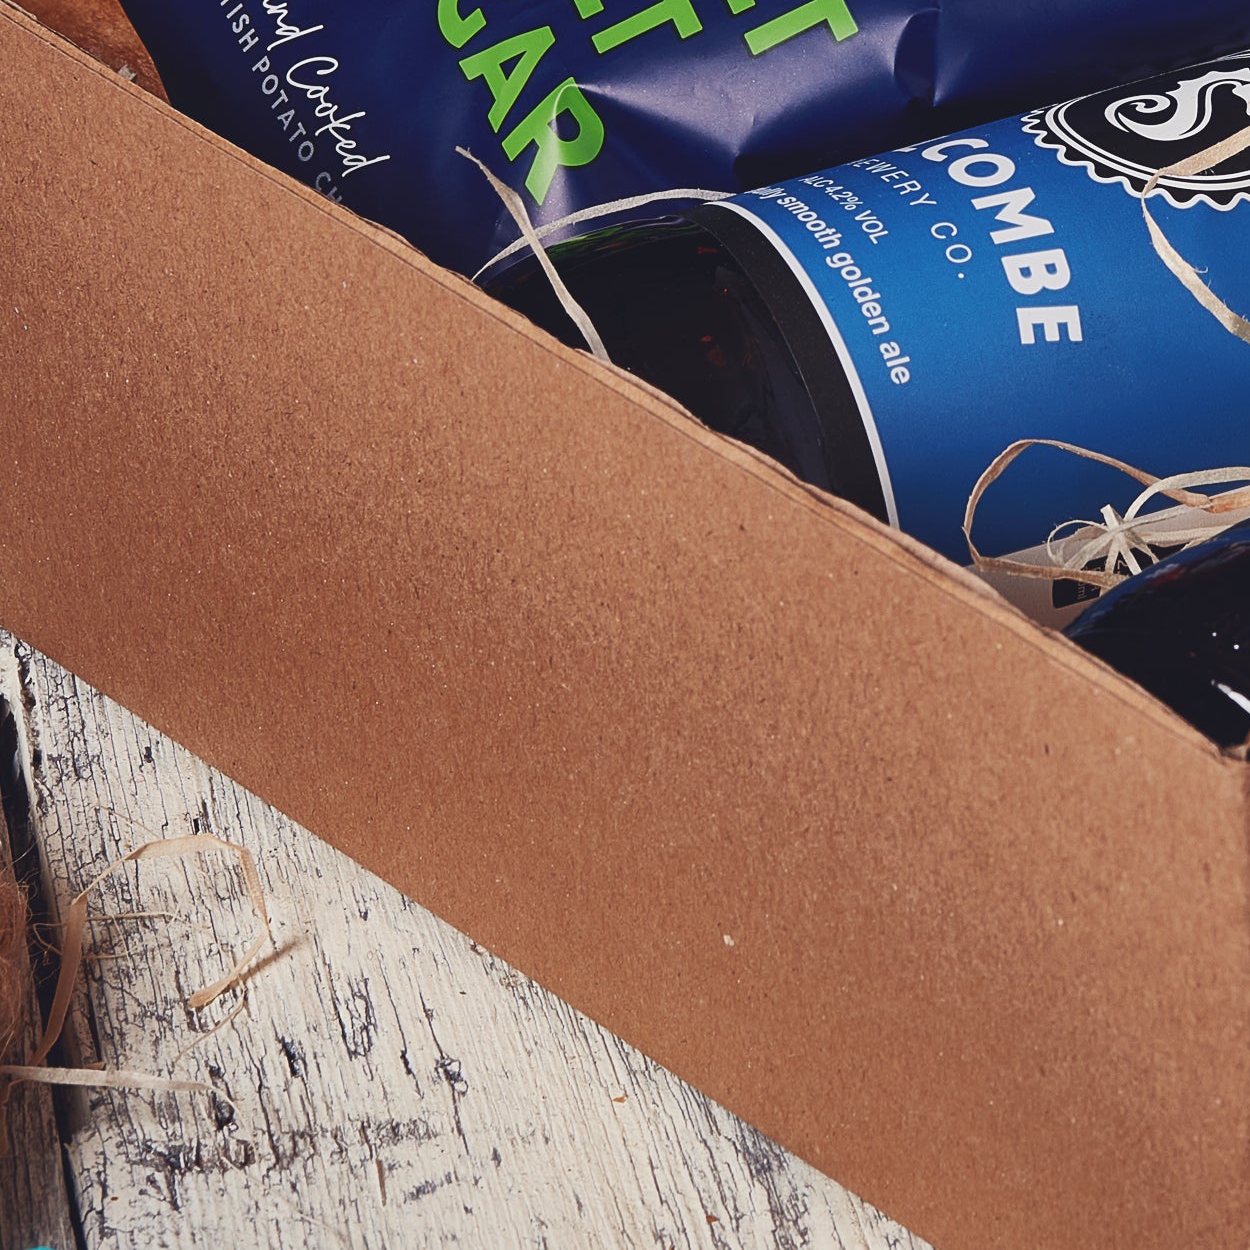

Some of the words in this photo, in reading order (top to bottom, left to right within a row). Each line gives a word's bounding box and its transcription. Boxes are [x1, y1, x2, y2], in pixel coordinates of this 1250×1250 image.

[252, 55, 315, 162] POTATO
[286, 56, 391, 178] Cooked
[824, 185, 864, 212] 4.2%
[854, 210, 889, 245] VOL
[891, 138, 1084, 345] COMBE
[930, 221, 973, 280] CO.
[776, 196, 843, 250] smooth
[825, 252, 891, 336] golden
[879, 341, 911, 386] ale
